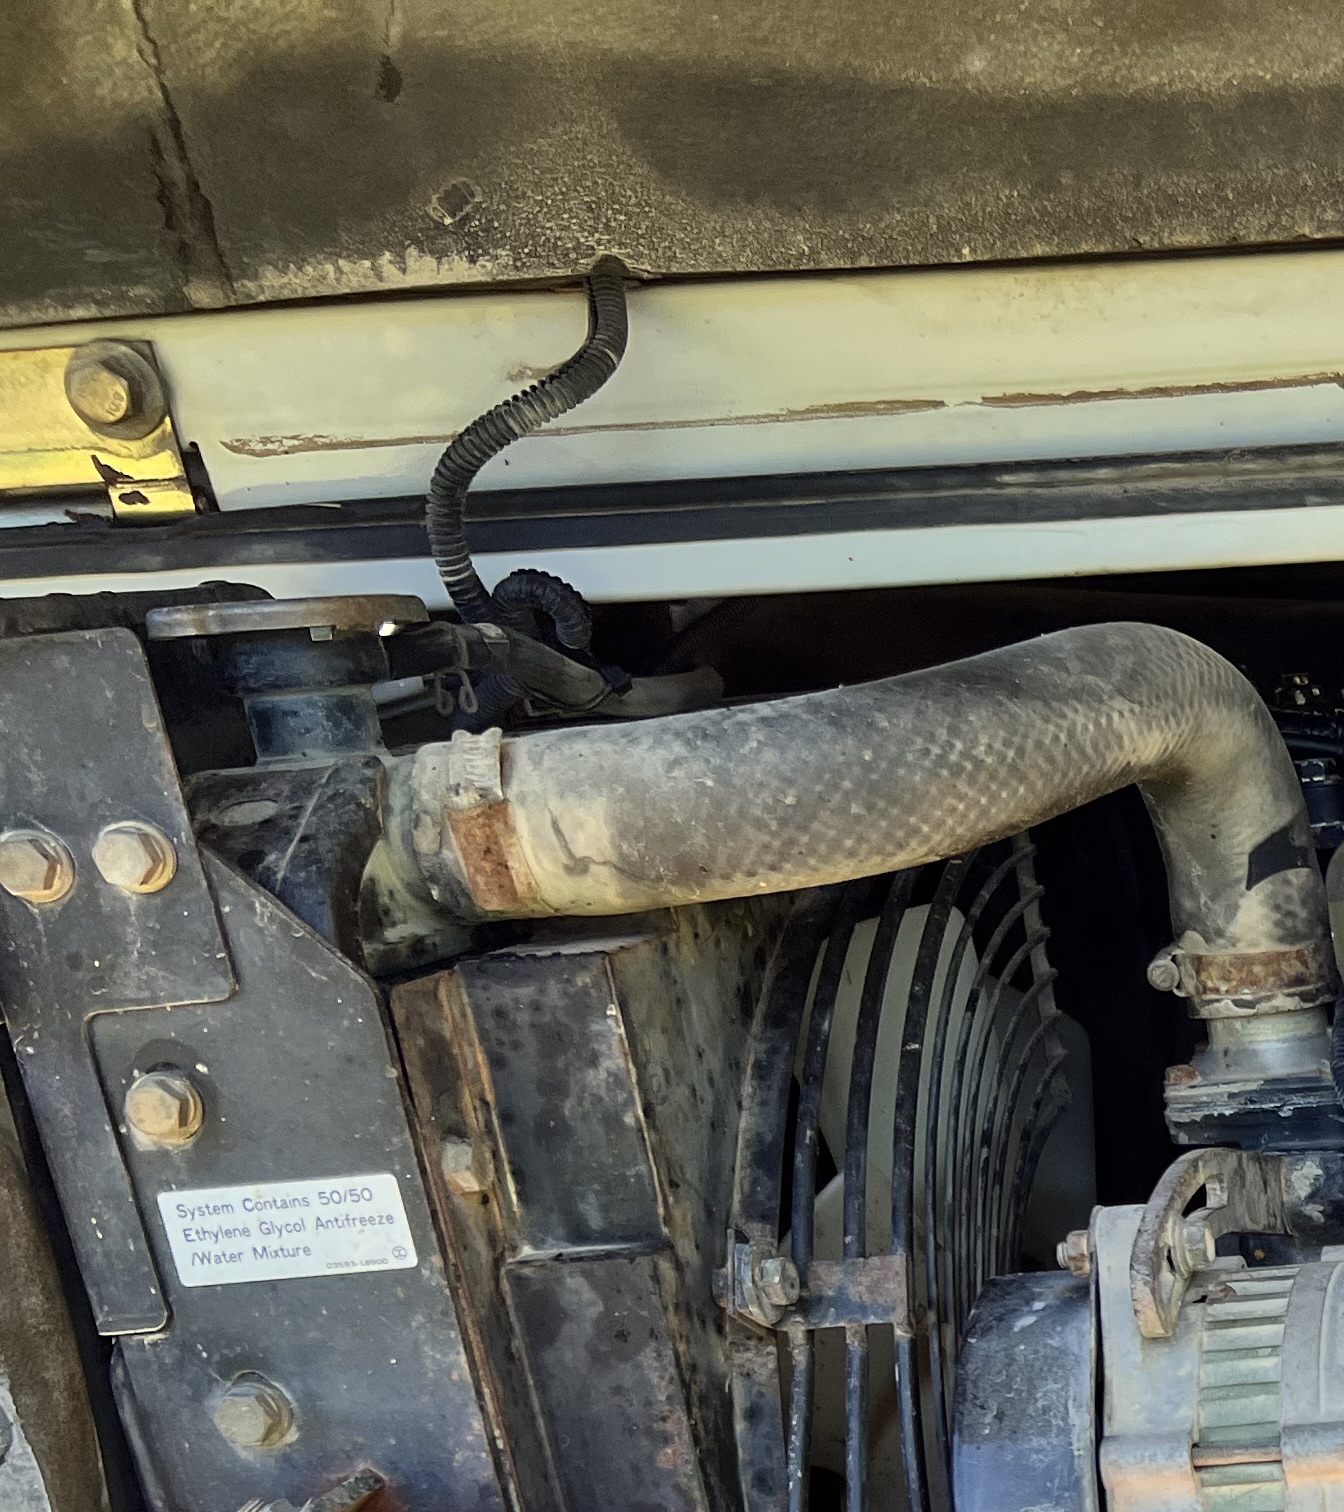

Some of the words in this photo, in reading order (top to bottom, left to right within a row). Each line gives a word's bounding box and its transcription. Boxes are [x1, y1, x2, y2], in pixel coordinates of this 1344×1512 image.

[175, 1202, 235, 1222] System
[242, 1194, 311, 1212] Contains
[317, 1187, 374, 1206] 50/50
[182, 1221, 251, 1244] Ethylene
[259, 1218, 306, 1239] Glycol
[315, 1212, 395, 1231] Antifreeze
[191, 1250, 244, 1267] /Water
[252, 1244, 312, 1261] Mixture
